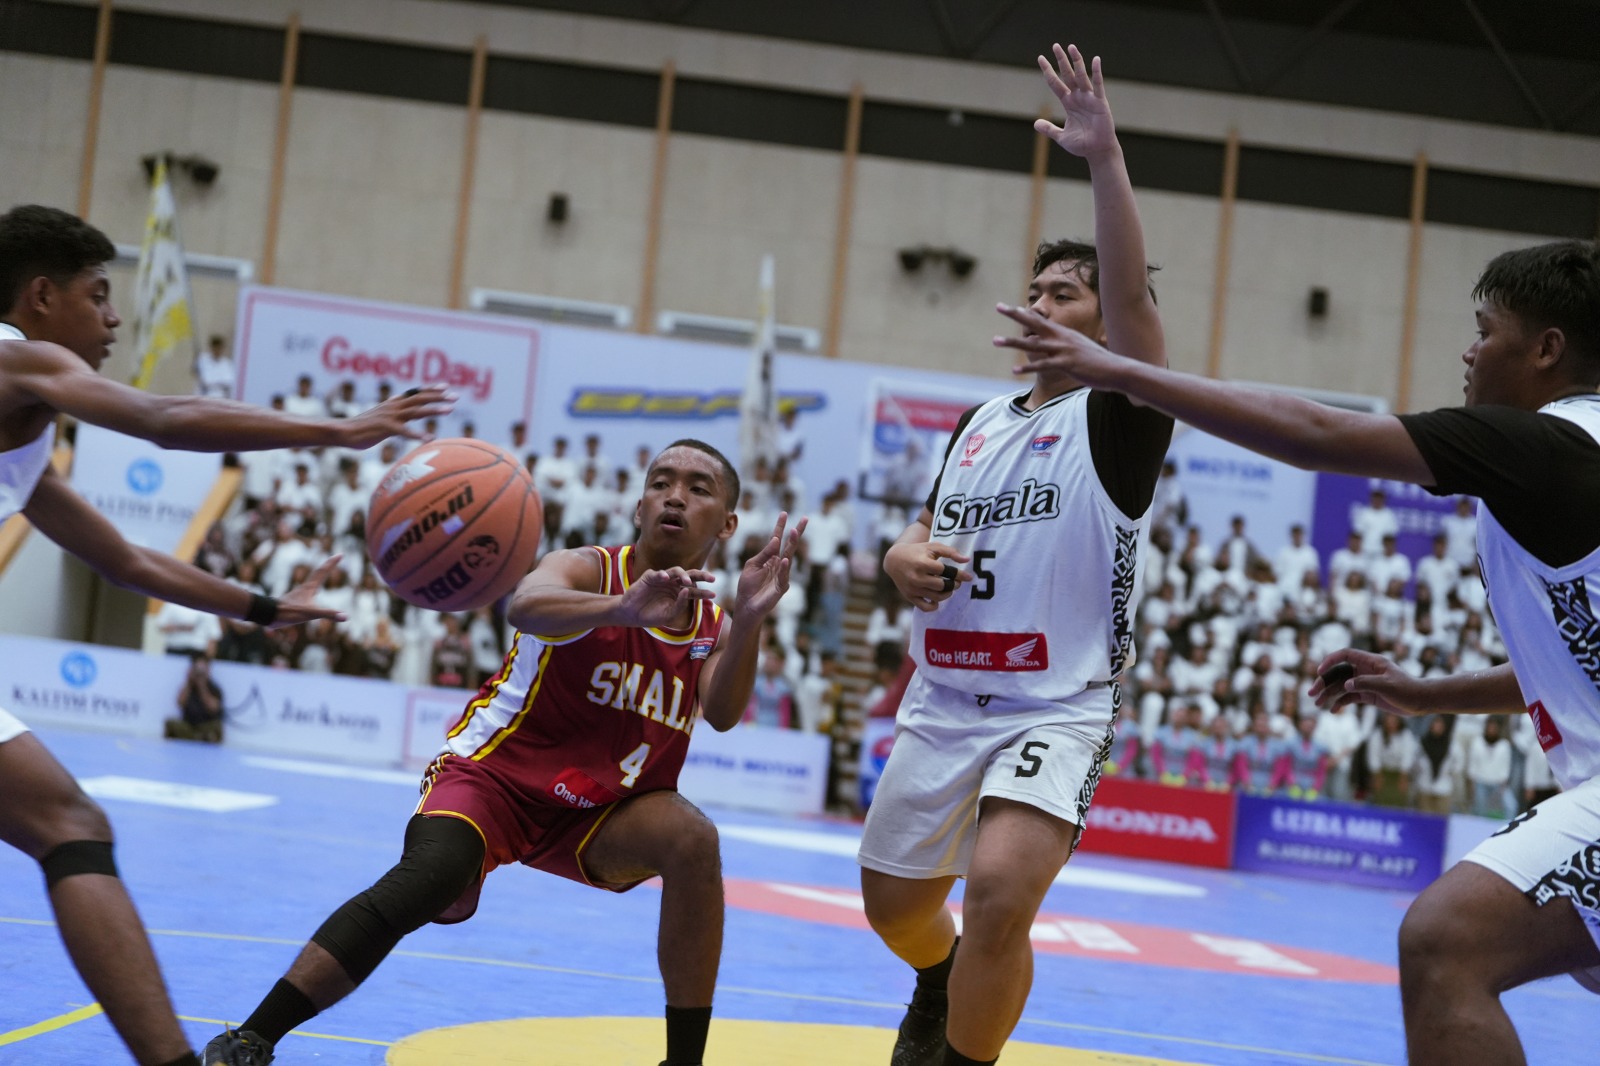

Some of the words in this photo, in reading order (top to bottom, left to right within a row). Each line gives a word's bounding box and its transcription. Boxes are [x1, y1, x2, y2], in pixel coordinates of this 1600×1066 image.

[320, 335, 418, 383] Good
[421, 347, 495, 404] Day
[933, 478, 1061, 538] Smala
[412, 561, 474, 604] DBL
[970, 549, 997, 600] 5
[929, 648, 953, 664] One
[1005, 660, 1041, 668] HONDA
[619, 742, 651, 790] 4
[553, 782, 577, 804] One
[1087, 805, 1218, 844] HONDA
